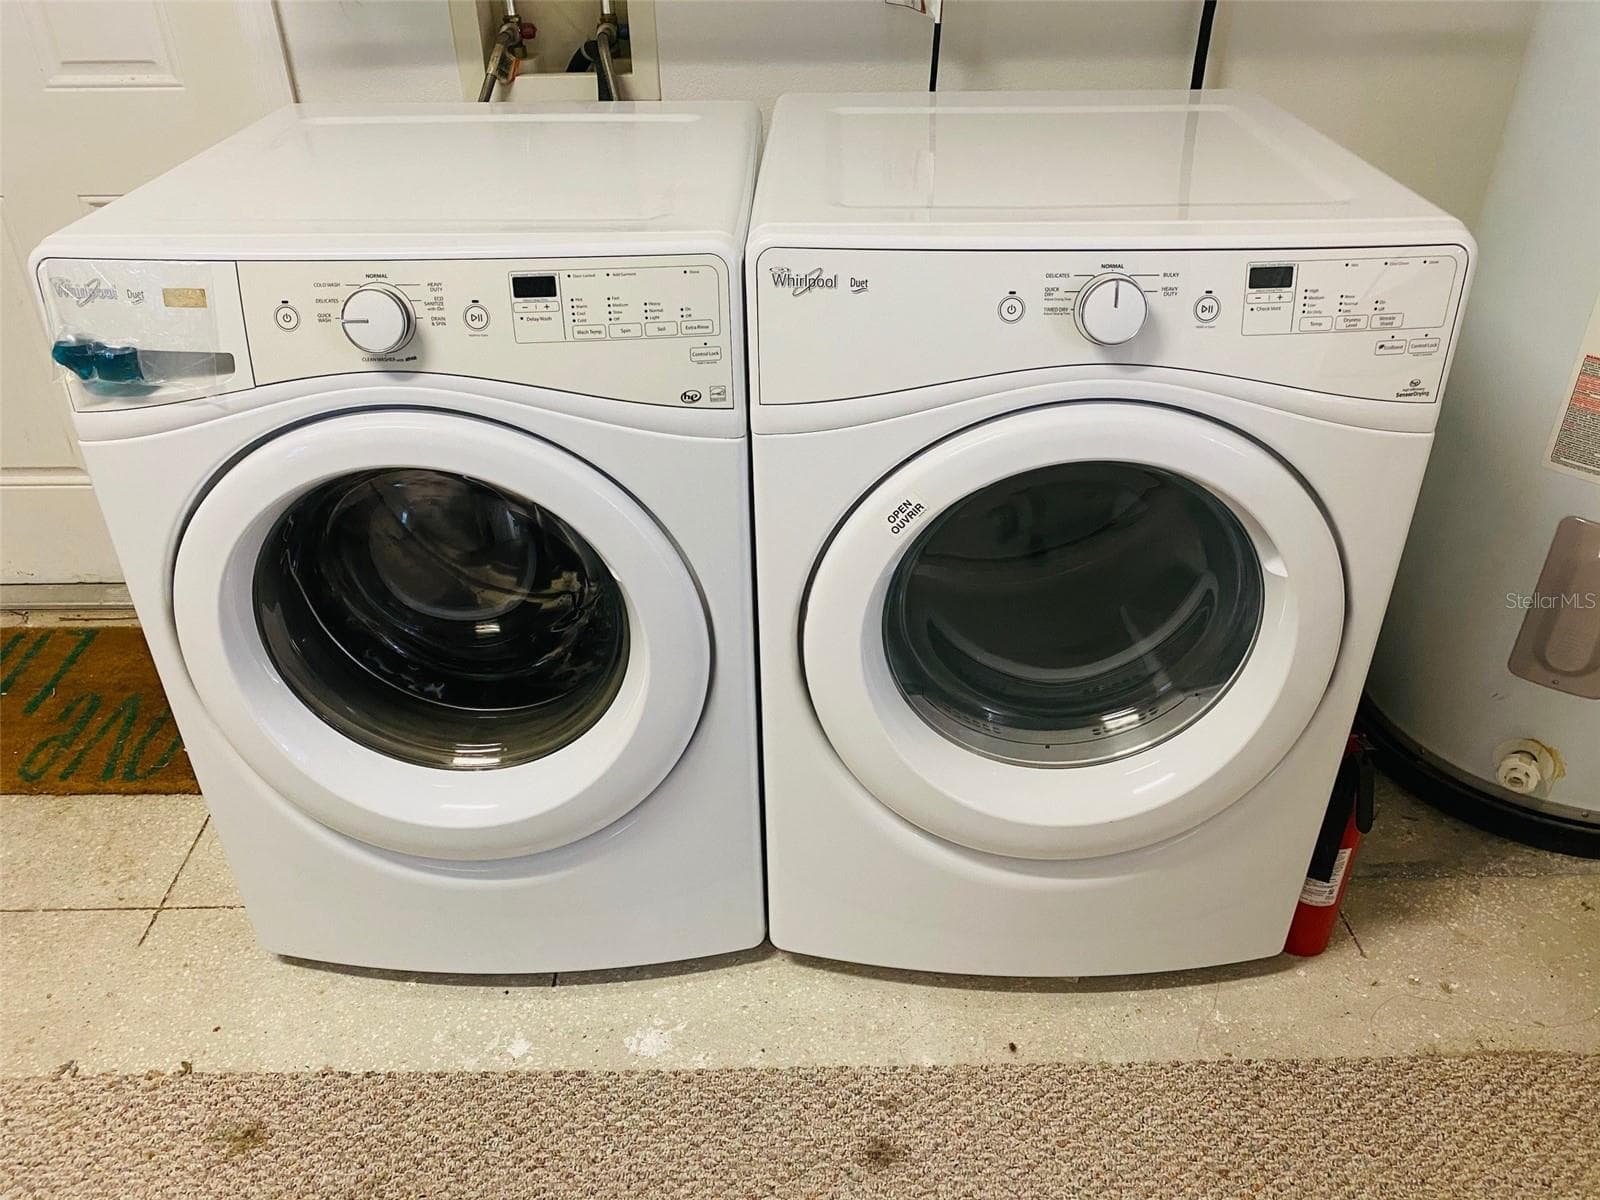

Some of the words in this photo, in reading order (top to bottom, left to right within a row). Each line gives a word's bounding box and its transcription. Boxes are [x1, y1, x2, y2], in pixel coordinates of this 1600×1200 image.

[770, 273, 837, 292] Whirlpool
[849, 277, 869, 288] Duet
[126, 288, 145, 300] Duet
[887, 499, 913, 524] OPEN
[891, 503, 925, 534] OUVRIR
